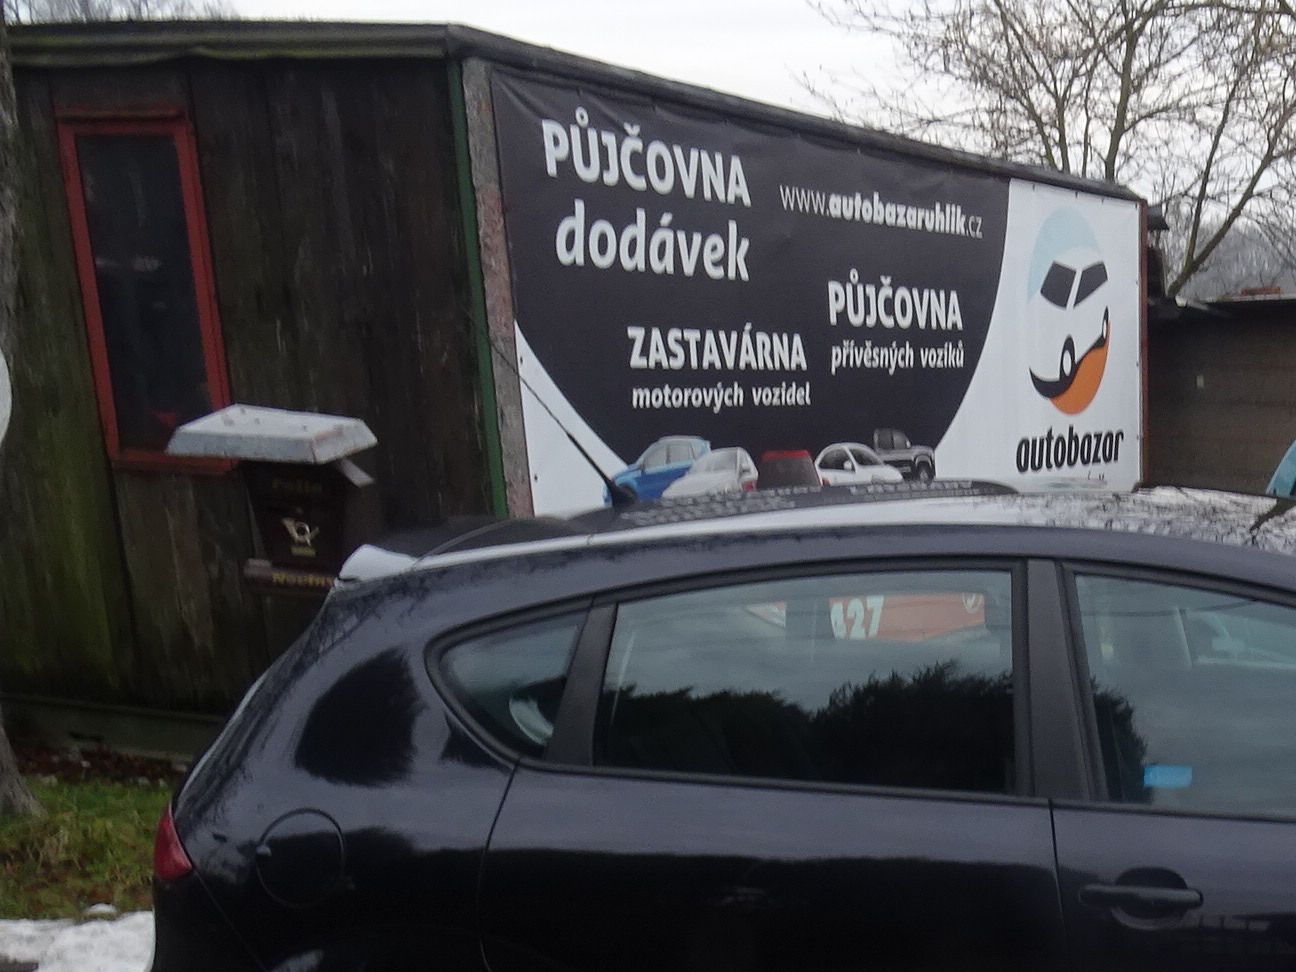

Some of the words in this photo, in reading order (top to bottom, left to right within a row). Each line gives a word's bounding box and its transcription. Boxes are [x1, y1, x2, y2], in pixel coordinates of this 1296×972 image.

[541, 106, 752, 208] PŮJČOVNA
[779, 184, 983, 239] www.autobazaruhlik.cz
[556, 198, 750, 281] dodávek
[828, 268, 963, 331] PŮJČOVNA
[627, 322, 808, 371] ZASTAVÁRNA
[831, 339, 914, 376] přívěsných
[920, 339, 965, 369] vozíků
[632, 381, 744, 414] motorových
[752, 381, 812, 406] vozidel
[1016, 424, 1124, 473] autobazar
